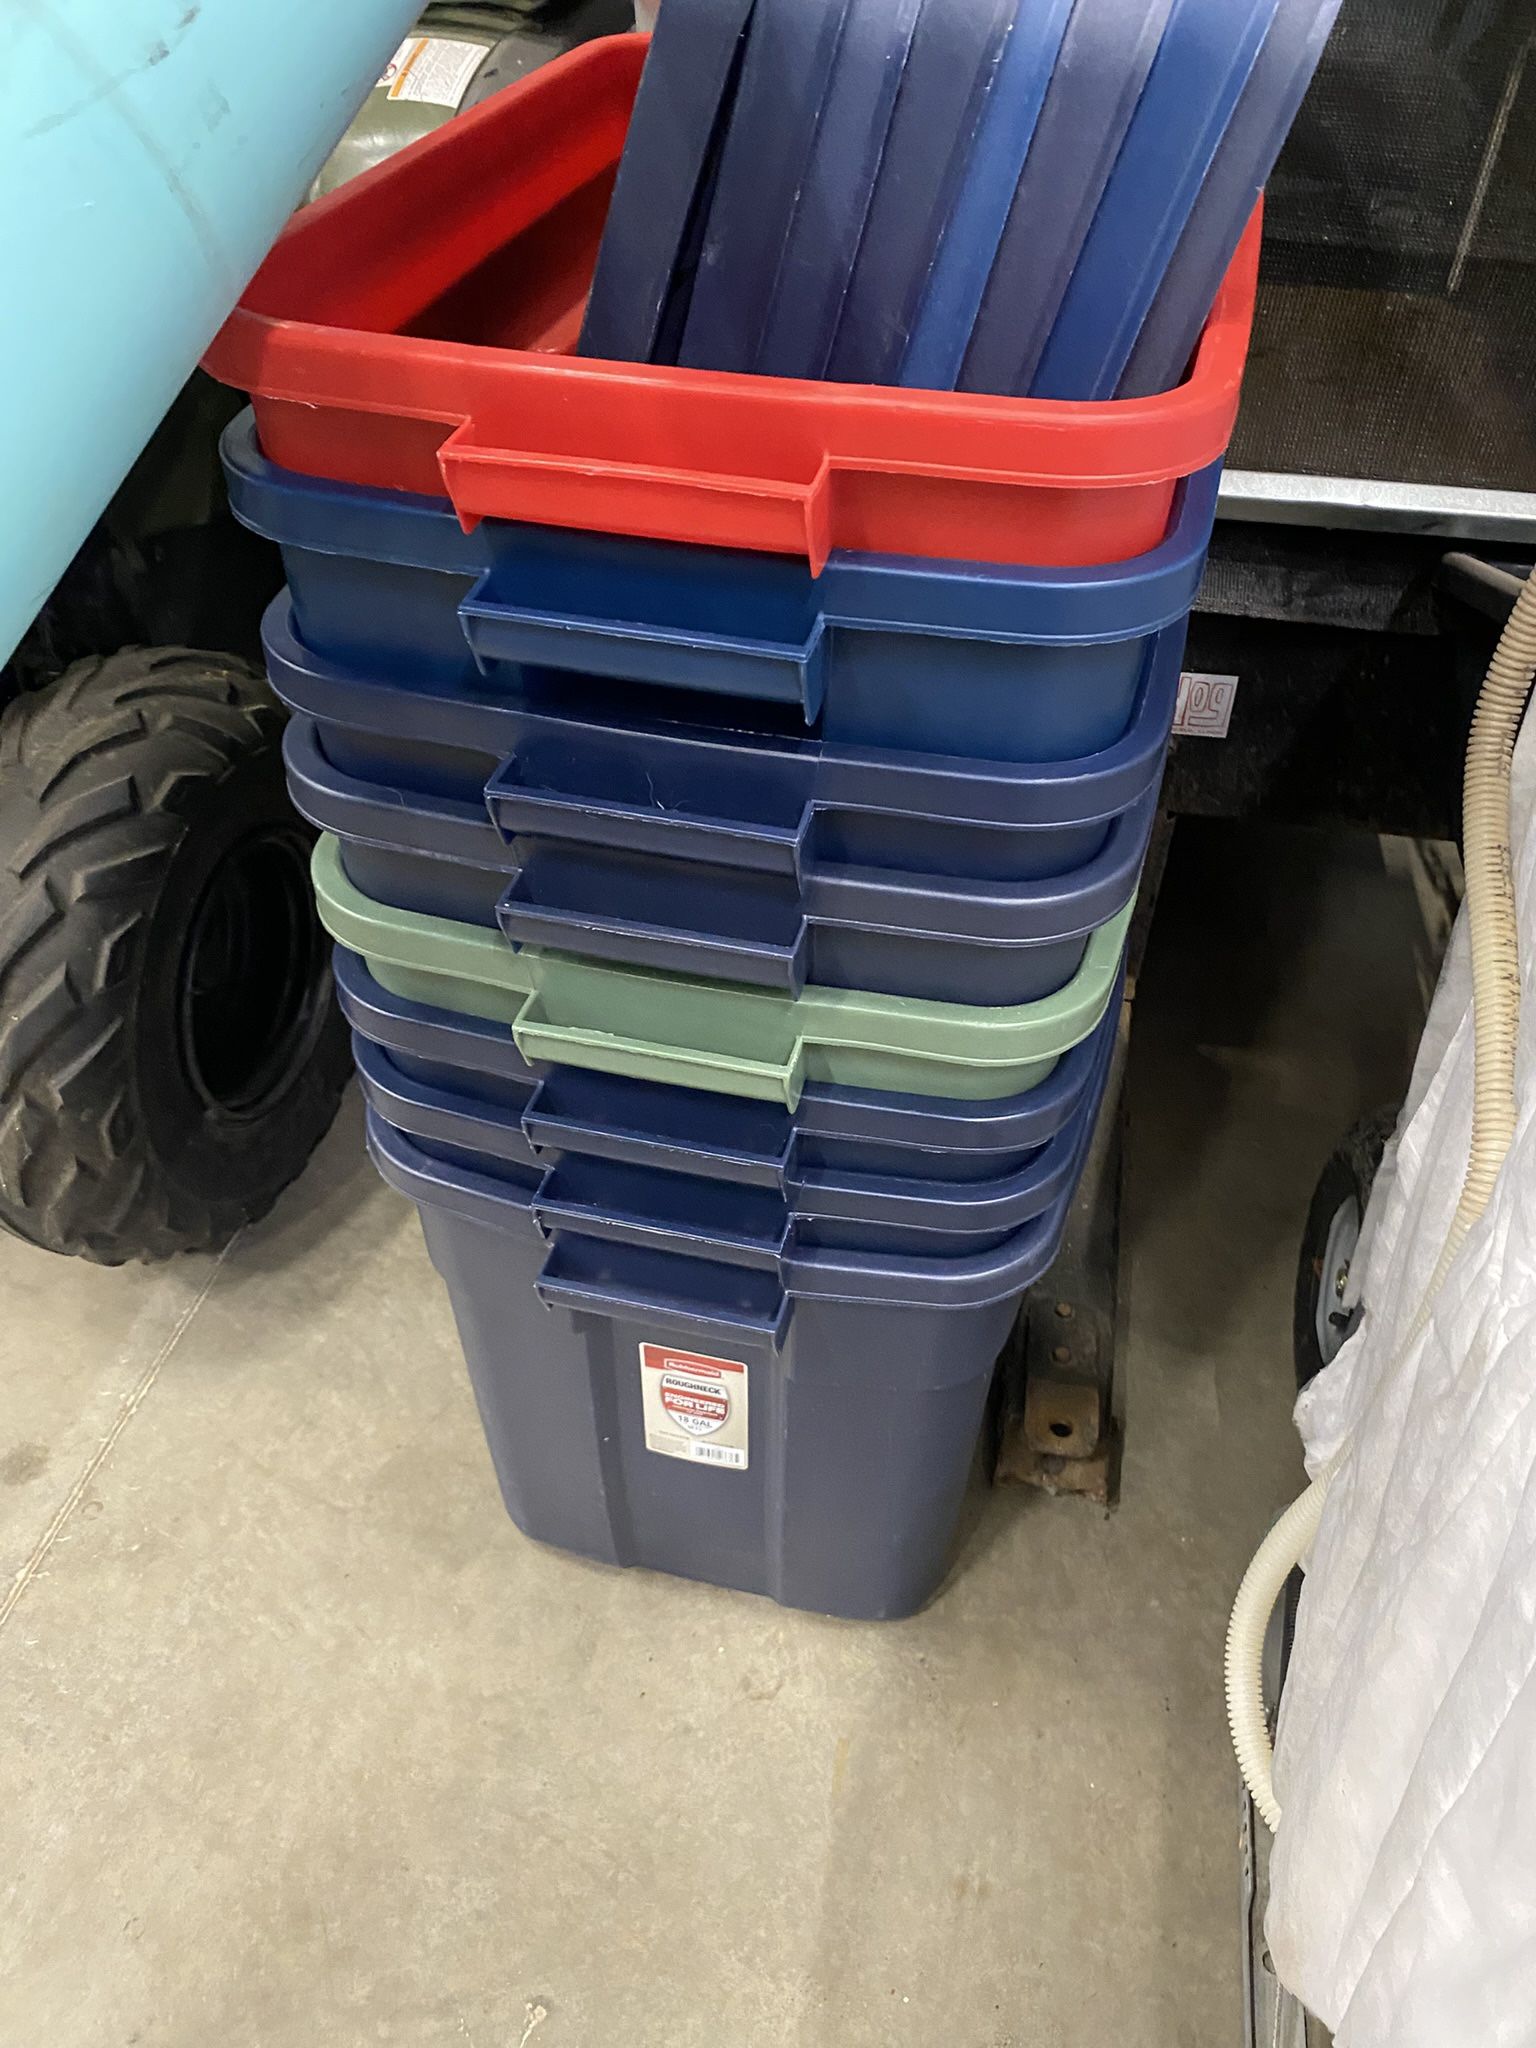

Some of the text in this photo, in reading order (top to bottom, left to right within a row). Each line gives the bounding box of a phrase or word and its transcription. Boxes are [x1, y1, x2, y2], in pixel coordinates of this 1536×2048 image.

[665, 1378, 722, 1395] ROUGHNECK
[665, 1397, 693, 1410] FOR
[692, 1418, 713, 1428] GAL
